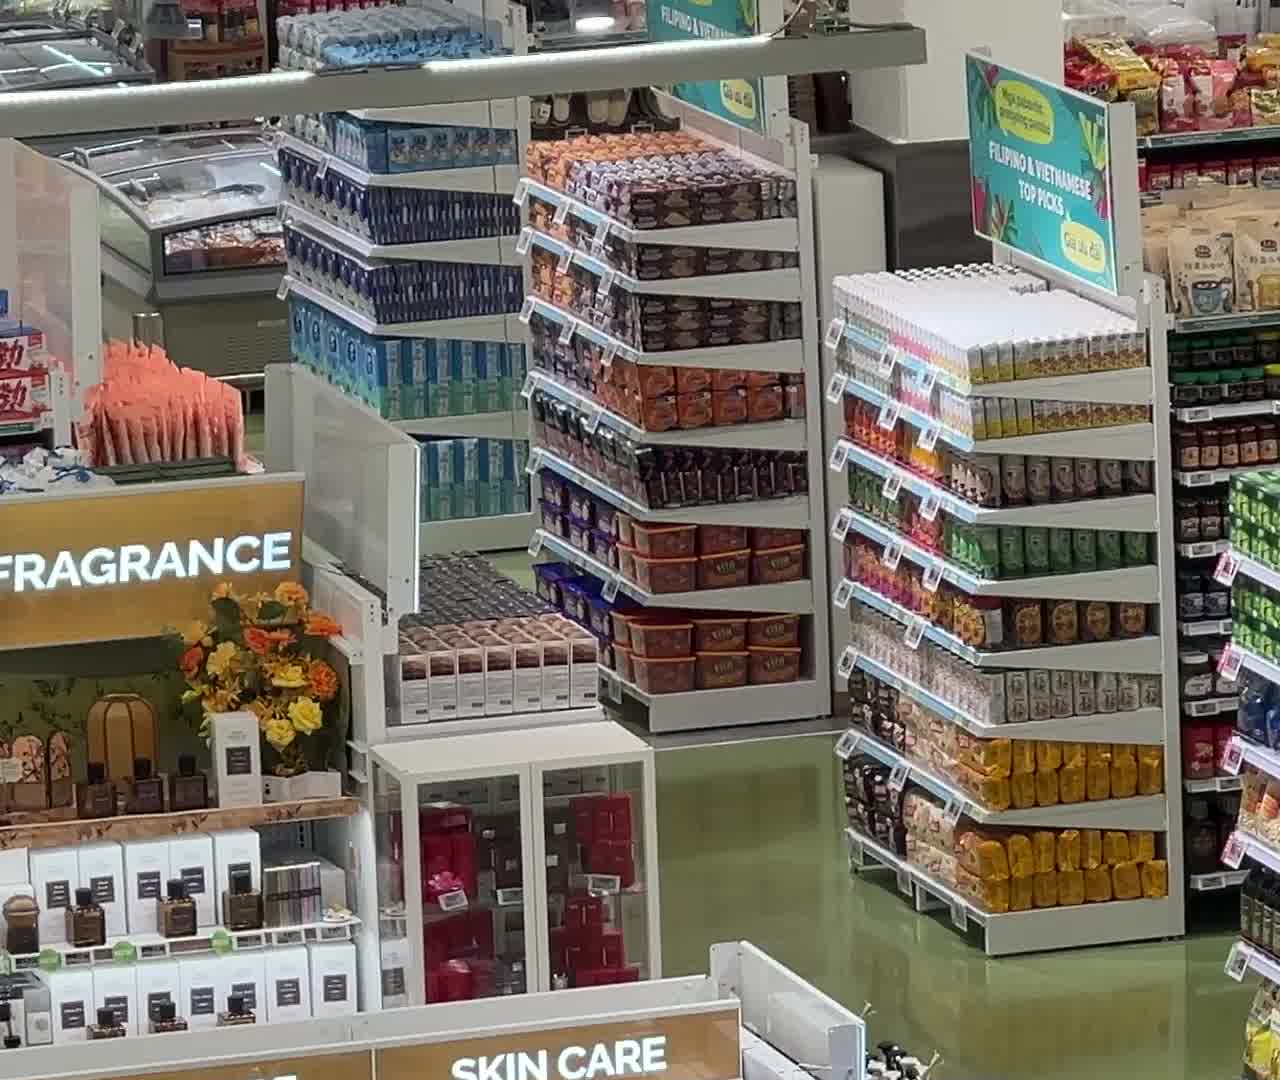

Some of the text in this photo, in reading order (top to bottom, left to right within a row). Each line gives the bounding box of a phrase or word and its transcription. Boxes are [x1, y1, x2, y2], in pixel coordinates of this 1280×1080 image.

[988, 140, 1093, 202] FILIPINO & VIETNAMESE
[1018, 179, 1064, 217] TOP PICKS
[556, 1034, 667, 1080] CARE
